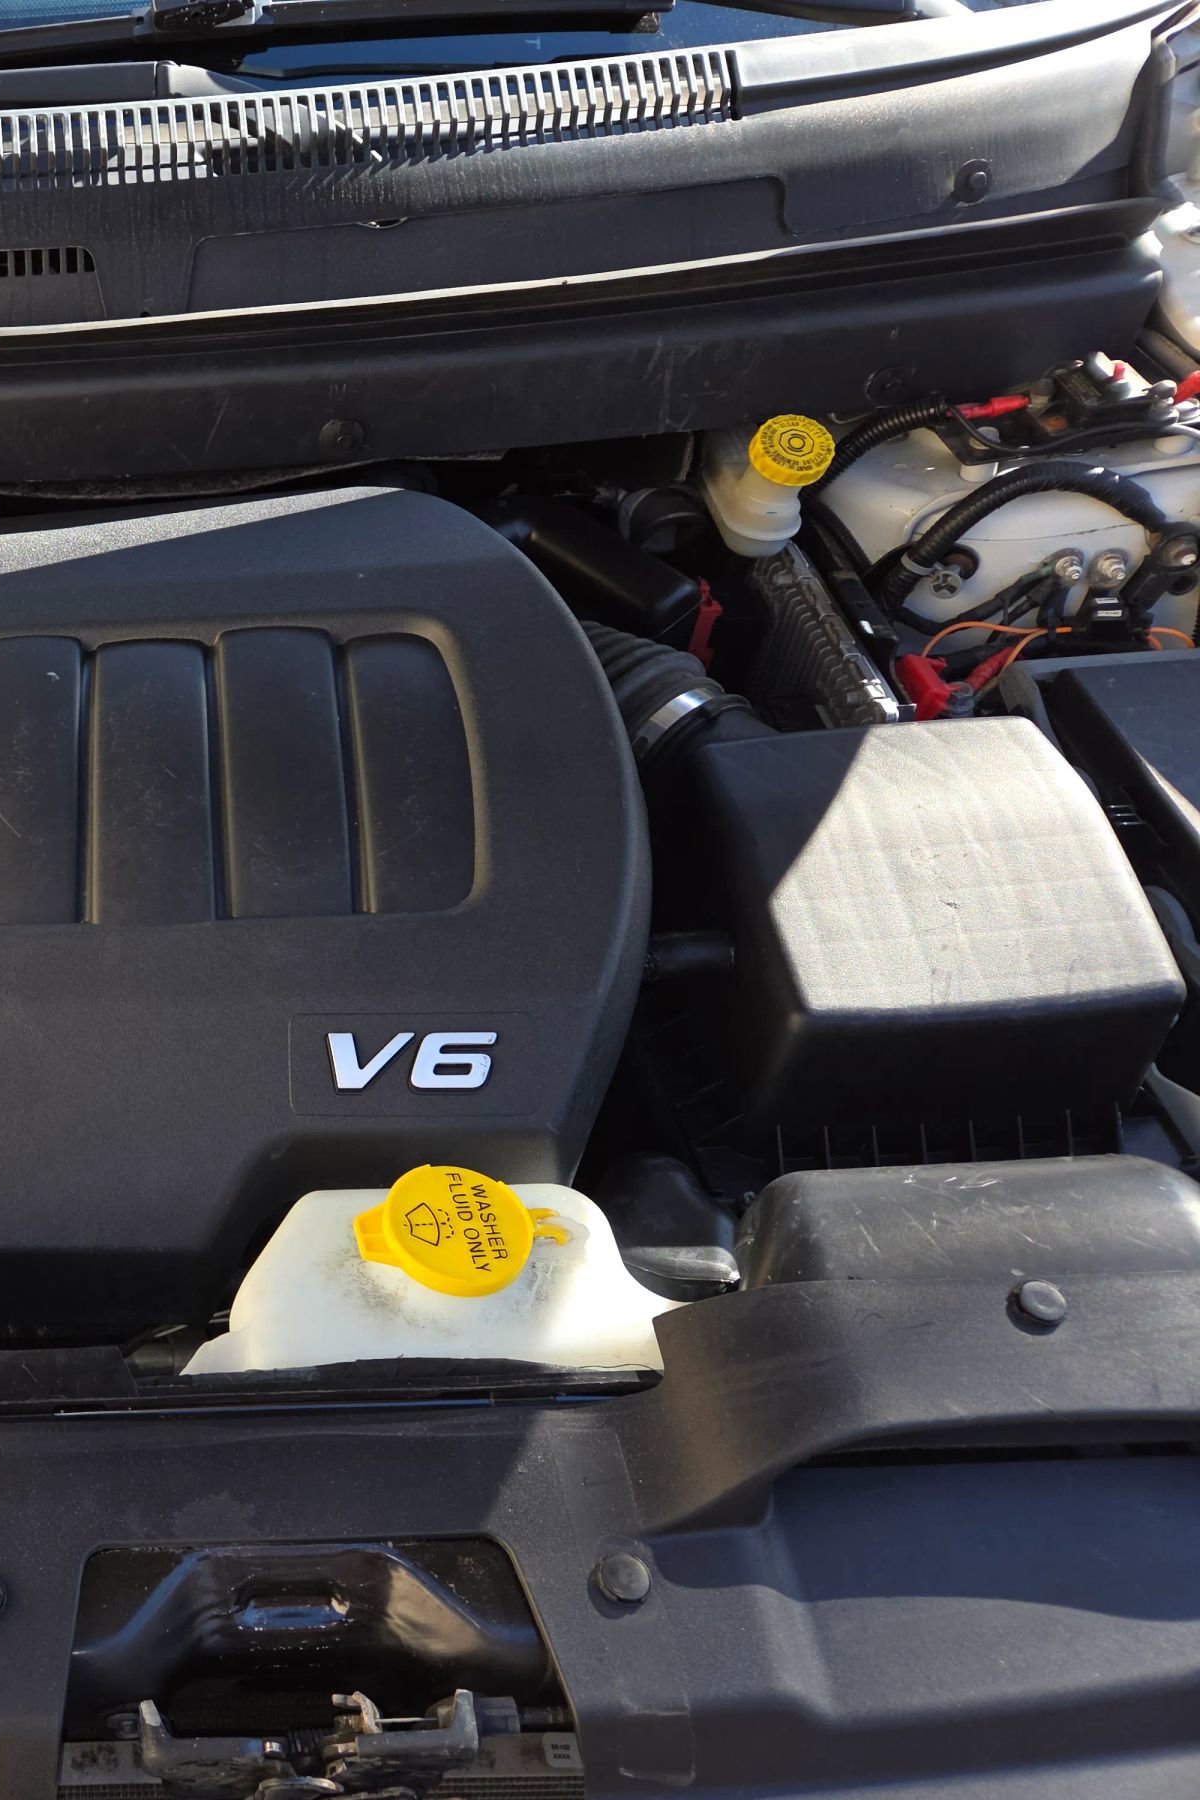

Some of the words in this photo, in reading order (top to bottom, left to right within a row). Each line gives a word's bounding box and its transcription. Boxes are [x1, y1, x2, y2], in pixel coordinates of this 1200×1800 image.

[326, 1032, 497, 1091] V6
[445, 1173, 473, 1221] FLUID
[463, 1228, 492, 1272] ONLY
[471, 1184, 508, 1259] WASHER
